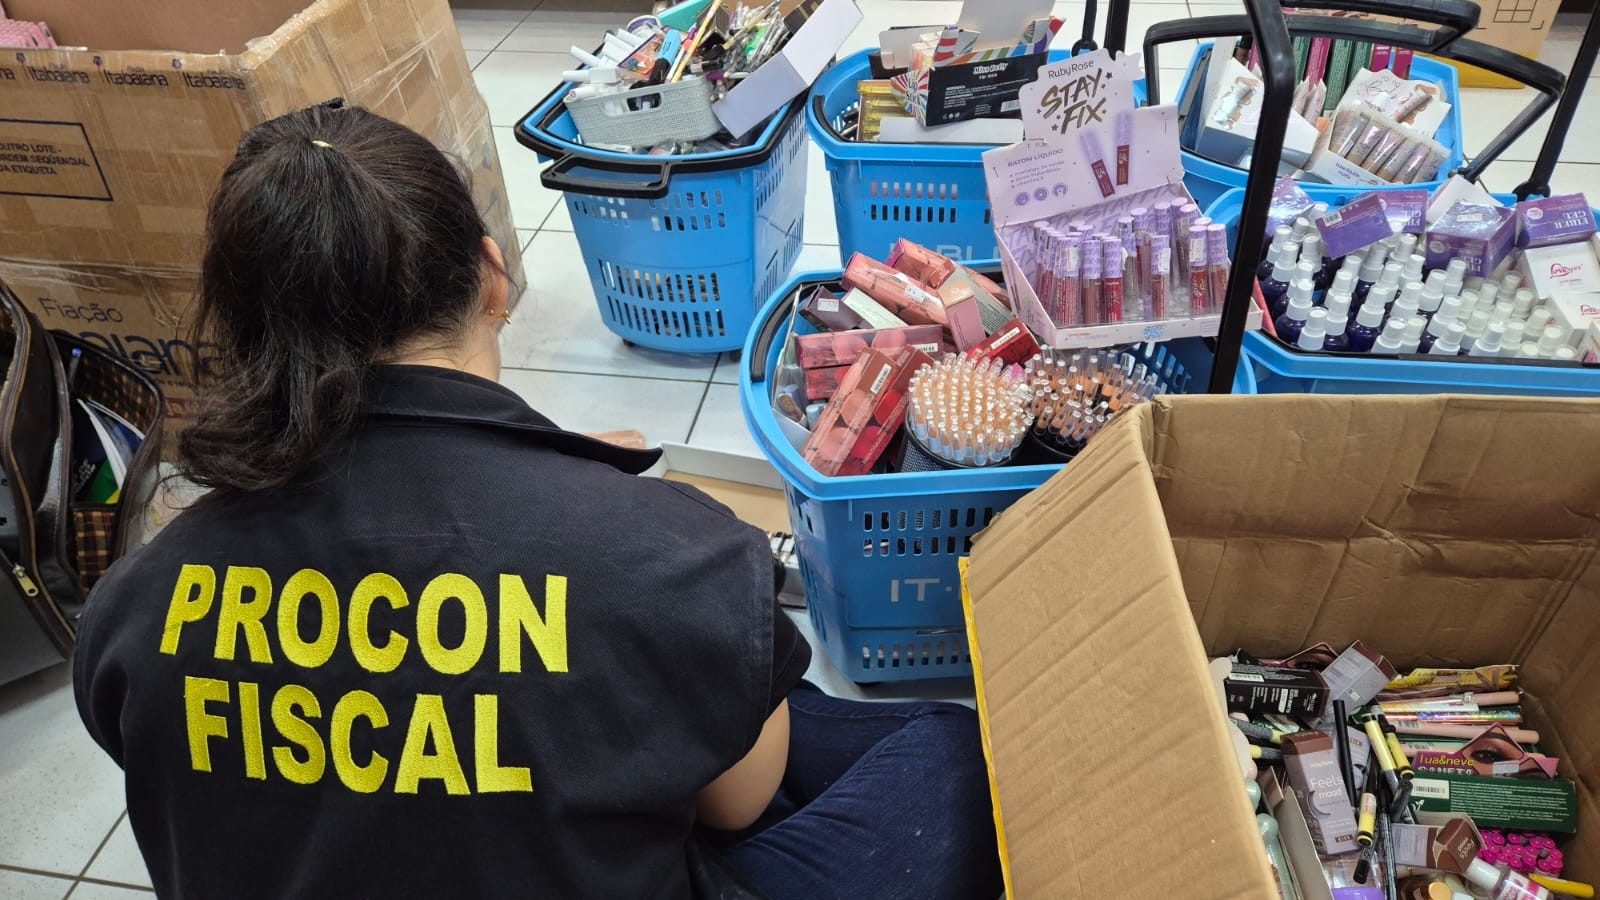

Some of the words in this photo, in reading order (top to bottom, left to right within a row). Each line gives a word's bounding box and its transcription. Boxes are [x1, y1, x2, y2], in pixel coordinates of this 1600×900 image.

[103, 69, 168, 87] Itabaiana
[1040, 67, 1103, 119] STAY
[1061, 97, 1107, 134] FIX
[31, 144, 57, 153] LOTE
[1007, 156, 1033, 167] BATOM
[11, 165, 57, 175] ETIQUETA
[1563, 211, 1587, 220] GEL
[1554, 218, 1590, 230] FIBER
[38, 298, 124, 323] Fiação
[159, 564, 569, 675] PROCON
[184, 675, 534, 795] FISCAL
[1310, 777, 1344, 789] Feels
[1319, 790, 1342, 800] mood
